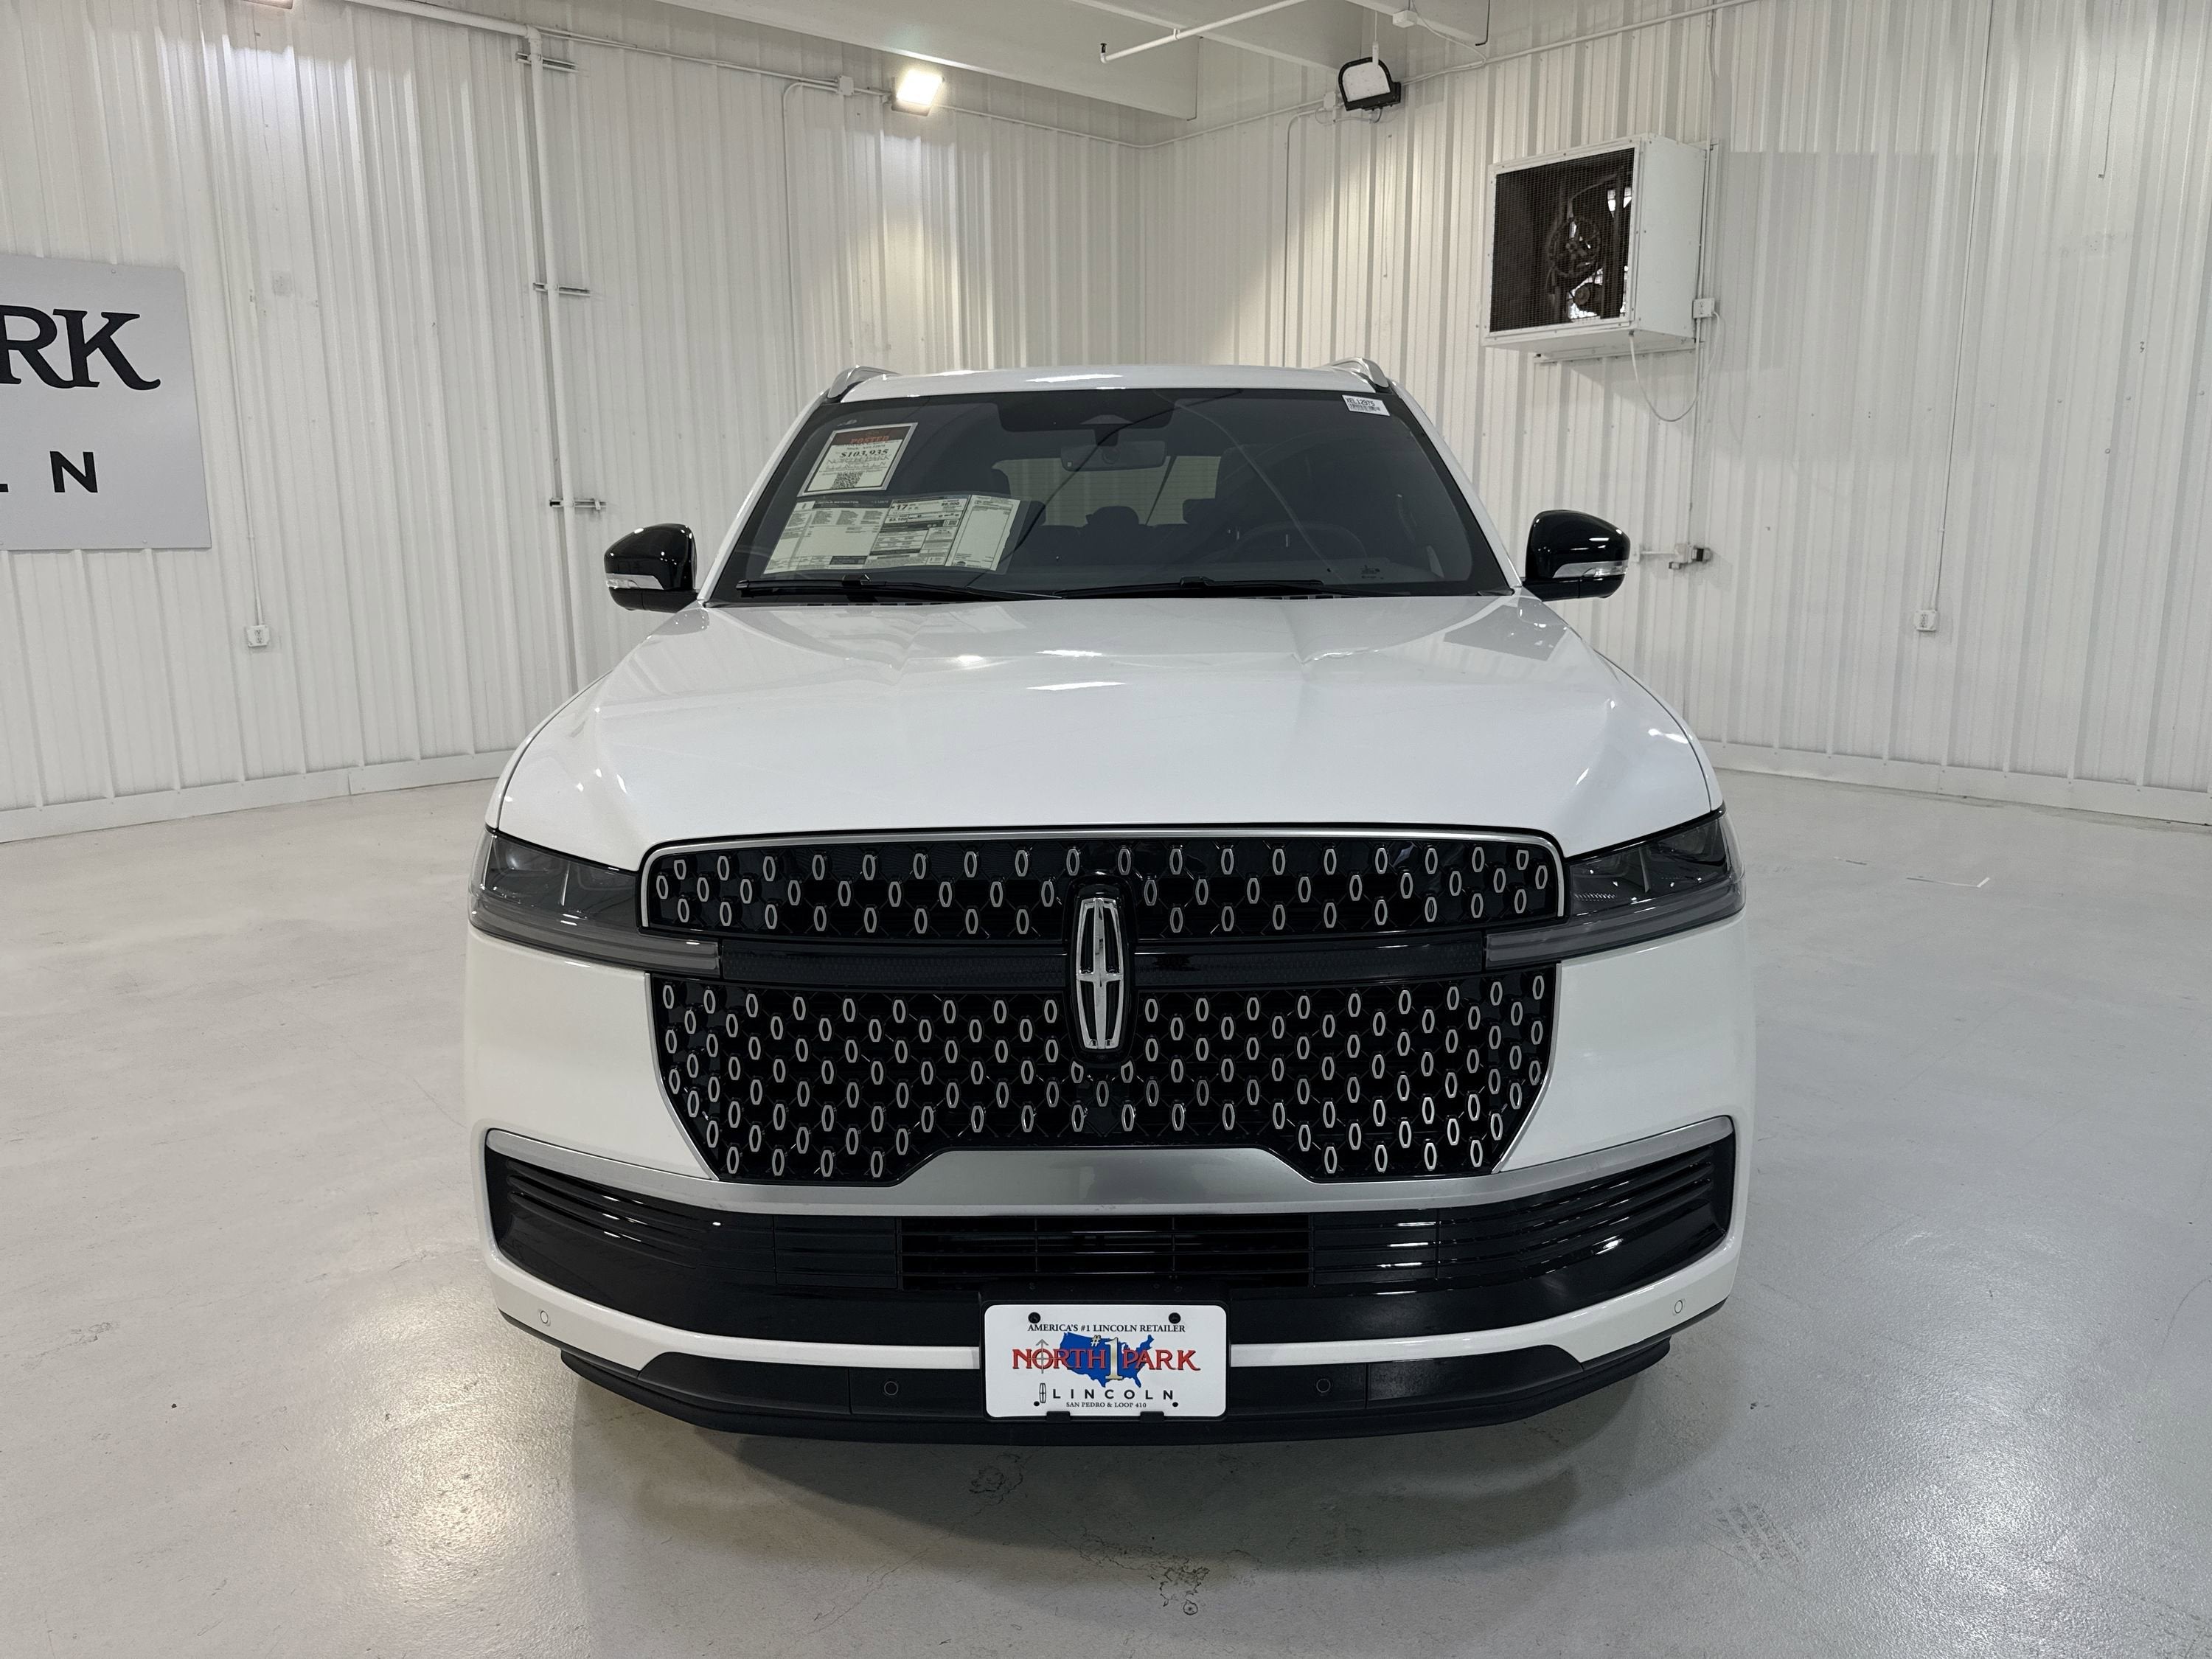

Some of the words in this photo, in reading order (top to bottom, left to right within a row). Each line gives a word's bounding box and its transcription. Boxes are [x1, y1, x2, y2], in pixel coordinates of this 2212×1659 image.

[840, 449, 889, 458] $103,935
[1027, 1324, 1078, 1332] AMERICA'S
[1140, 1324, 1186, 1332] RETAILER
[1012, 1348, 1105, 1370] NORTH
[1121, 1348, 1201, 1371] PARK
[1053, 1388, 1173, 1400] LINCOLN
